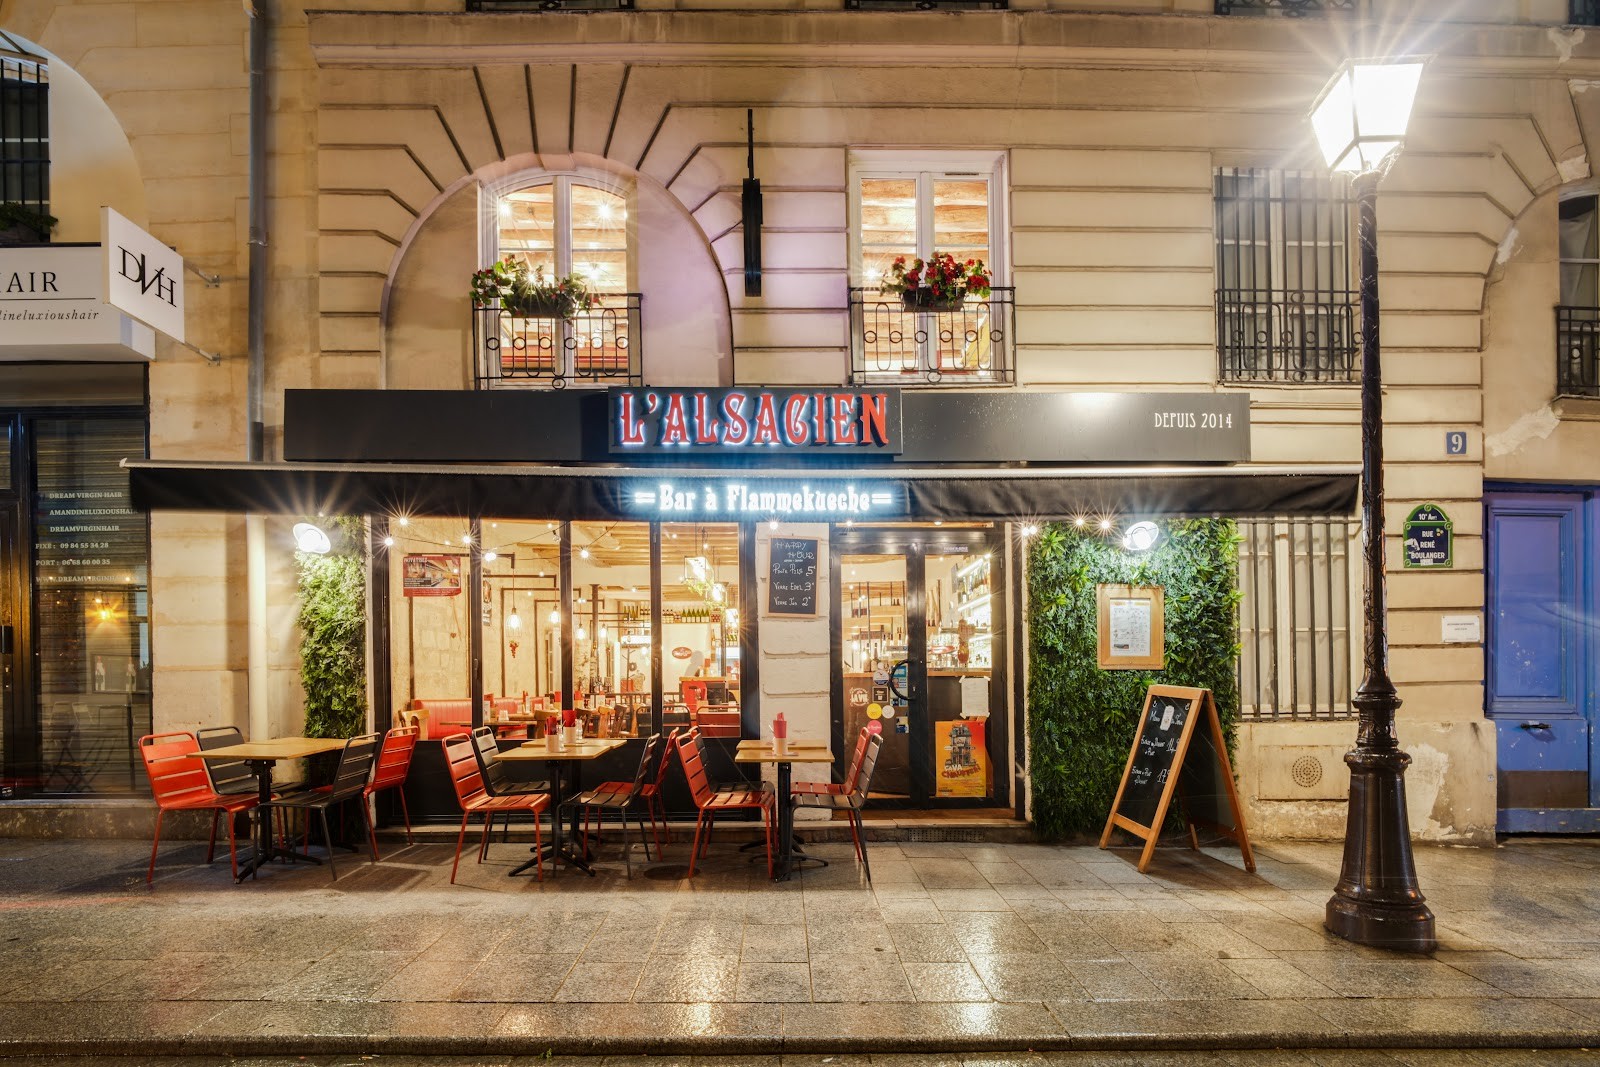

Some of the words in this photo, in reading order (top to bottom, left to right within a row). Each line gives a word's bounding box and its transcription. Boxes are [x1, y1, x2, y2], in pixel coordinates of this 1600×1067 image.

[0, 271, 60, 293] AIR
[620, 392, 889, 445] L'ALSACIEN
[1154, 412, 1196, 428] DEPUIS
[1200, 413, 1233, 429] 2014
[1451, 434, 1463, 453] 9
[659, 484, 696, 511] Bar
[705, 486, 718, 511] à
[727, 484, 870, 513] Flammekueche
[49, 525, 120, 533] DREAMVIRGINHAIR
[1421, 530, 1434, 538] RUE
[774, 541, 807, 550] HAPPY
[1420, 540, 1436, 549] RENÉ
[1410, 551, 1446, 559] BOULANGER
